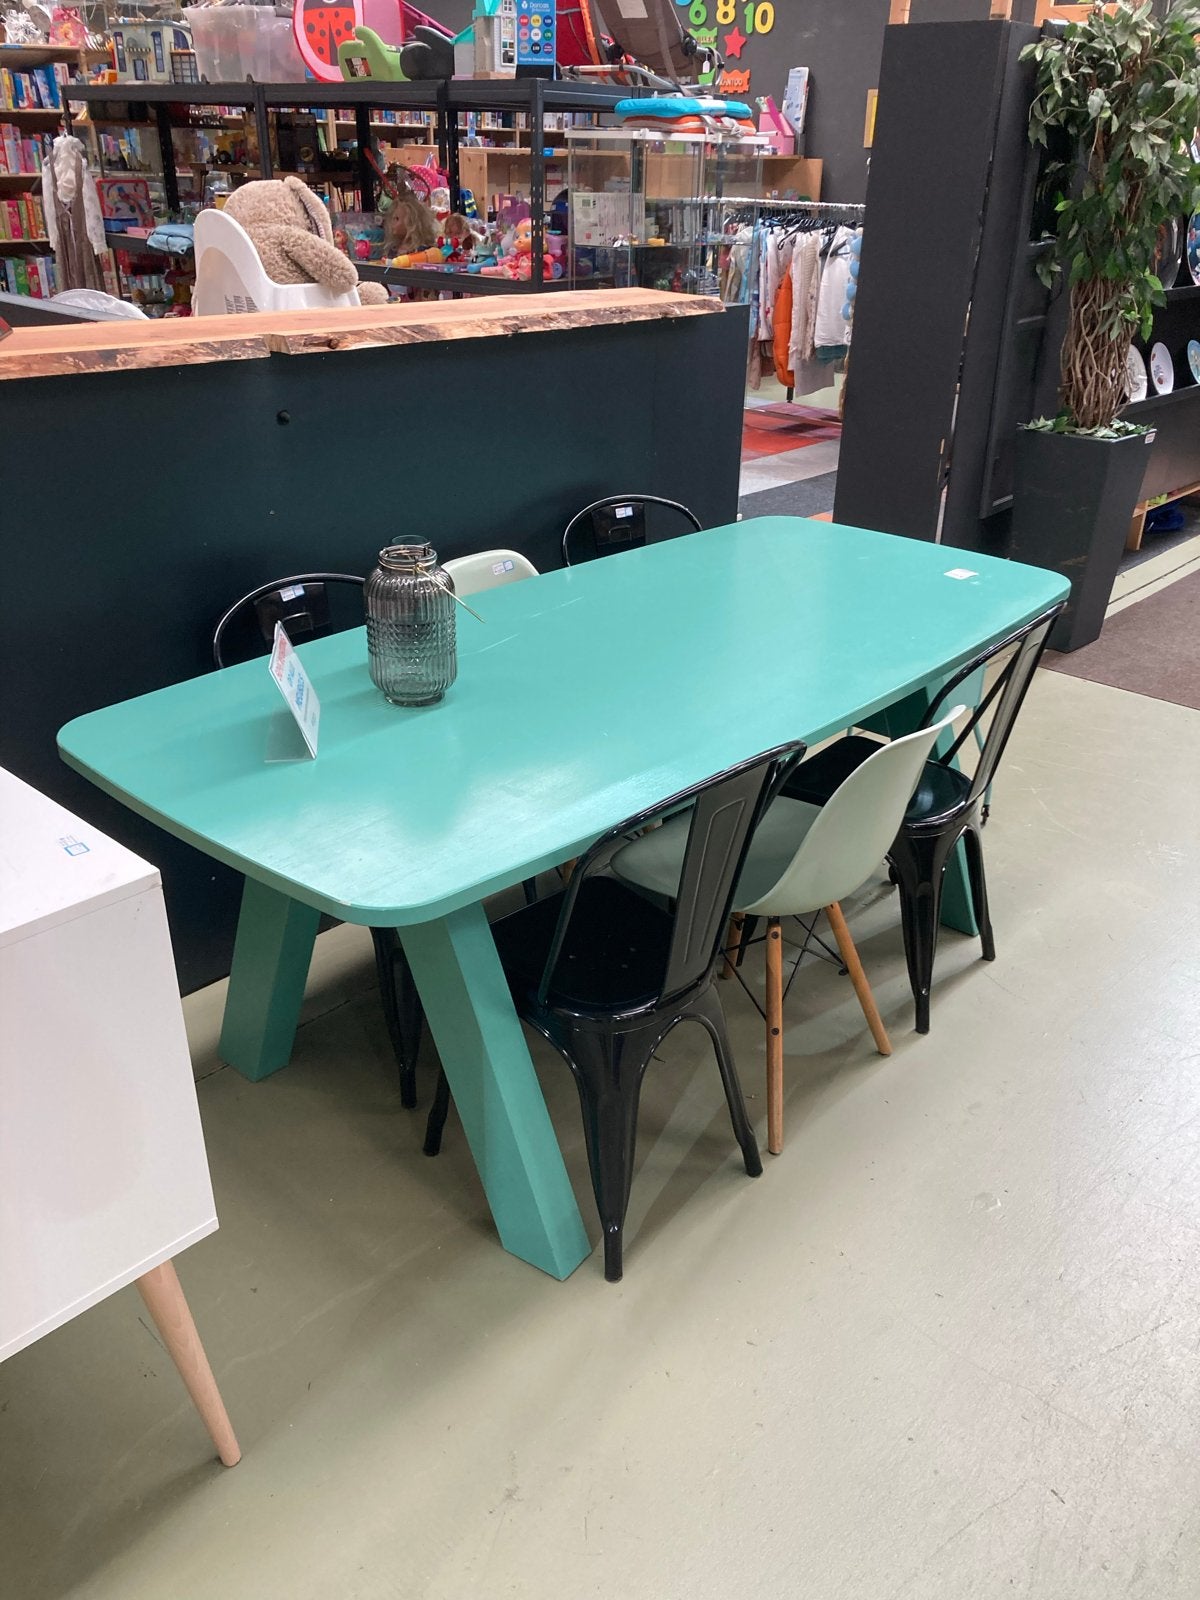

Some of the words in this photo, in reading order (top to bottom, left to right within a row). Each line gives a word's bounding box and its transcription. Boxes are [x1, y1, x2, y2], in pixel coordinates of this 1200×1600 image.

[688, 0, 707, 25] 6
[716, 0, 736, 25] 8
[744, 2, 775, 34] 10
